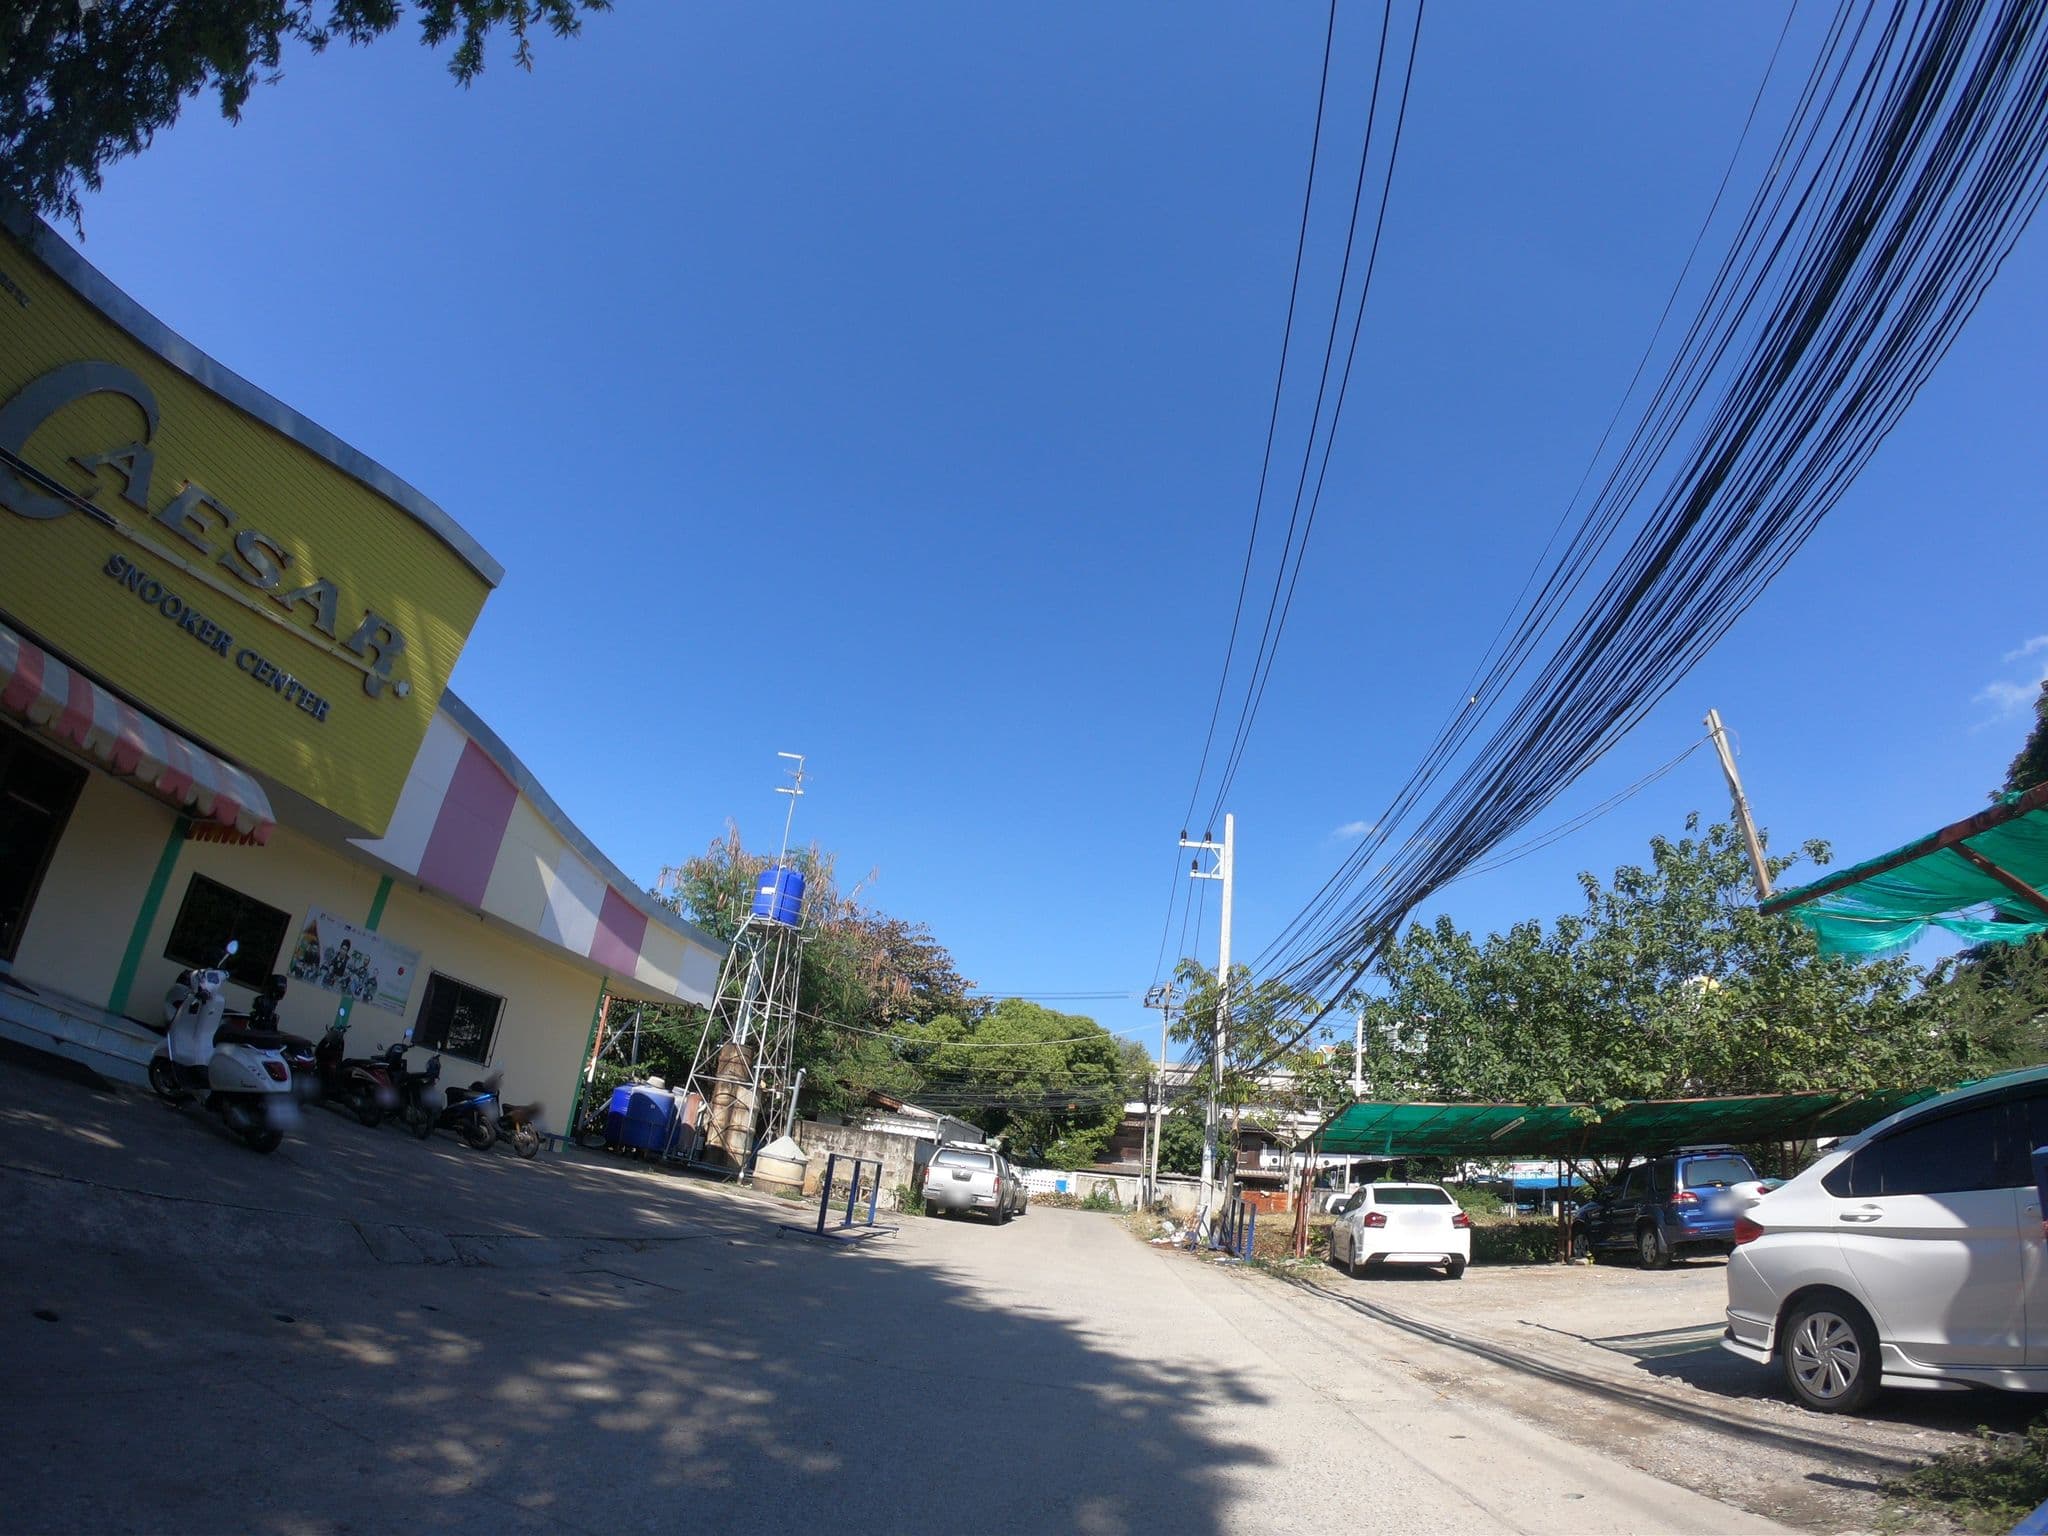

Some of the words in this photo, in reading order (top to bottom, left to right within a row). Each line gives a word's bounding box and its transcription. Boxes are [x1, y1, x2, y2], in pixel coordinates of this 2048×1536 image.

[0, 360, 408, 698] CAESAR
[103, 553, 235, 658] SNOOKER
[236, 649, 331, 722] CENTER
